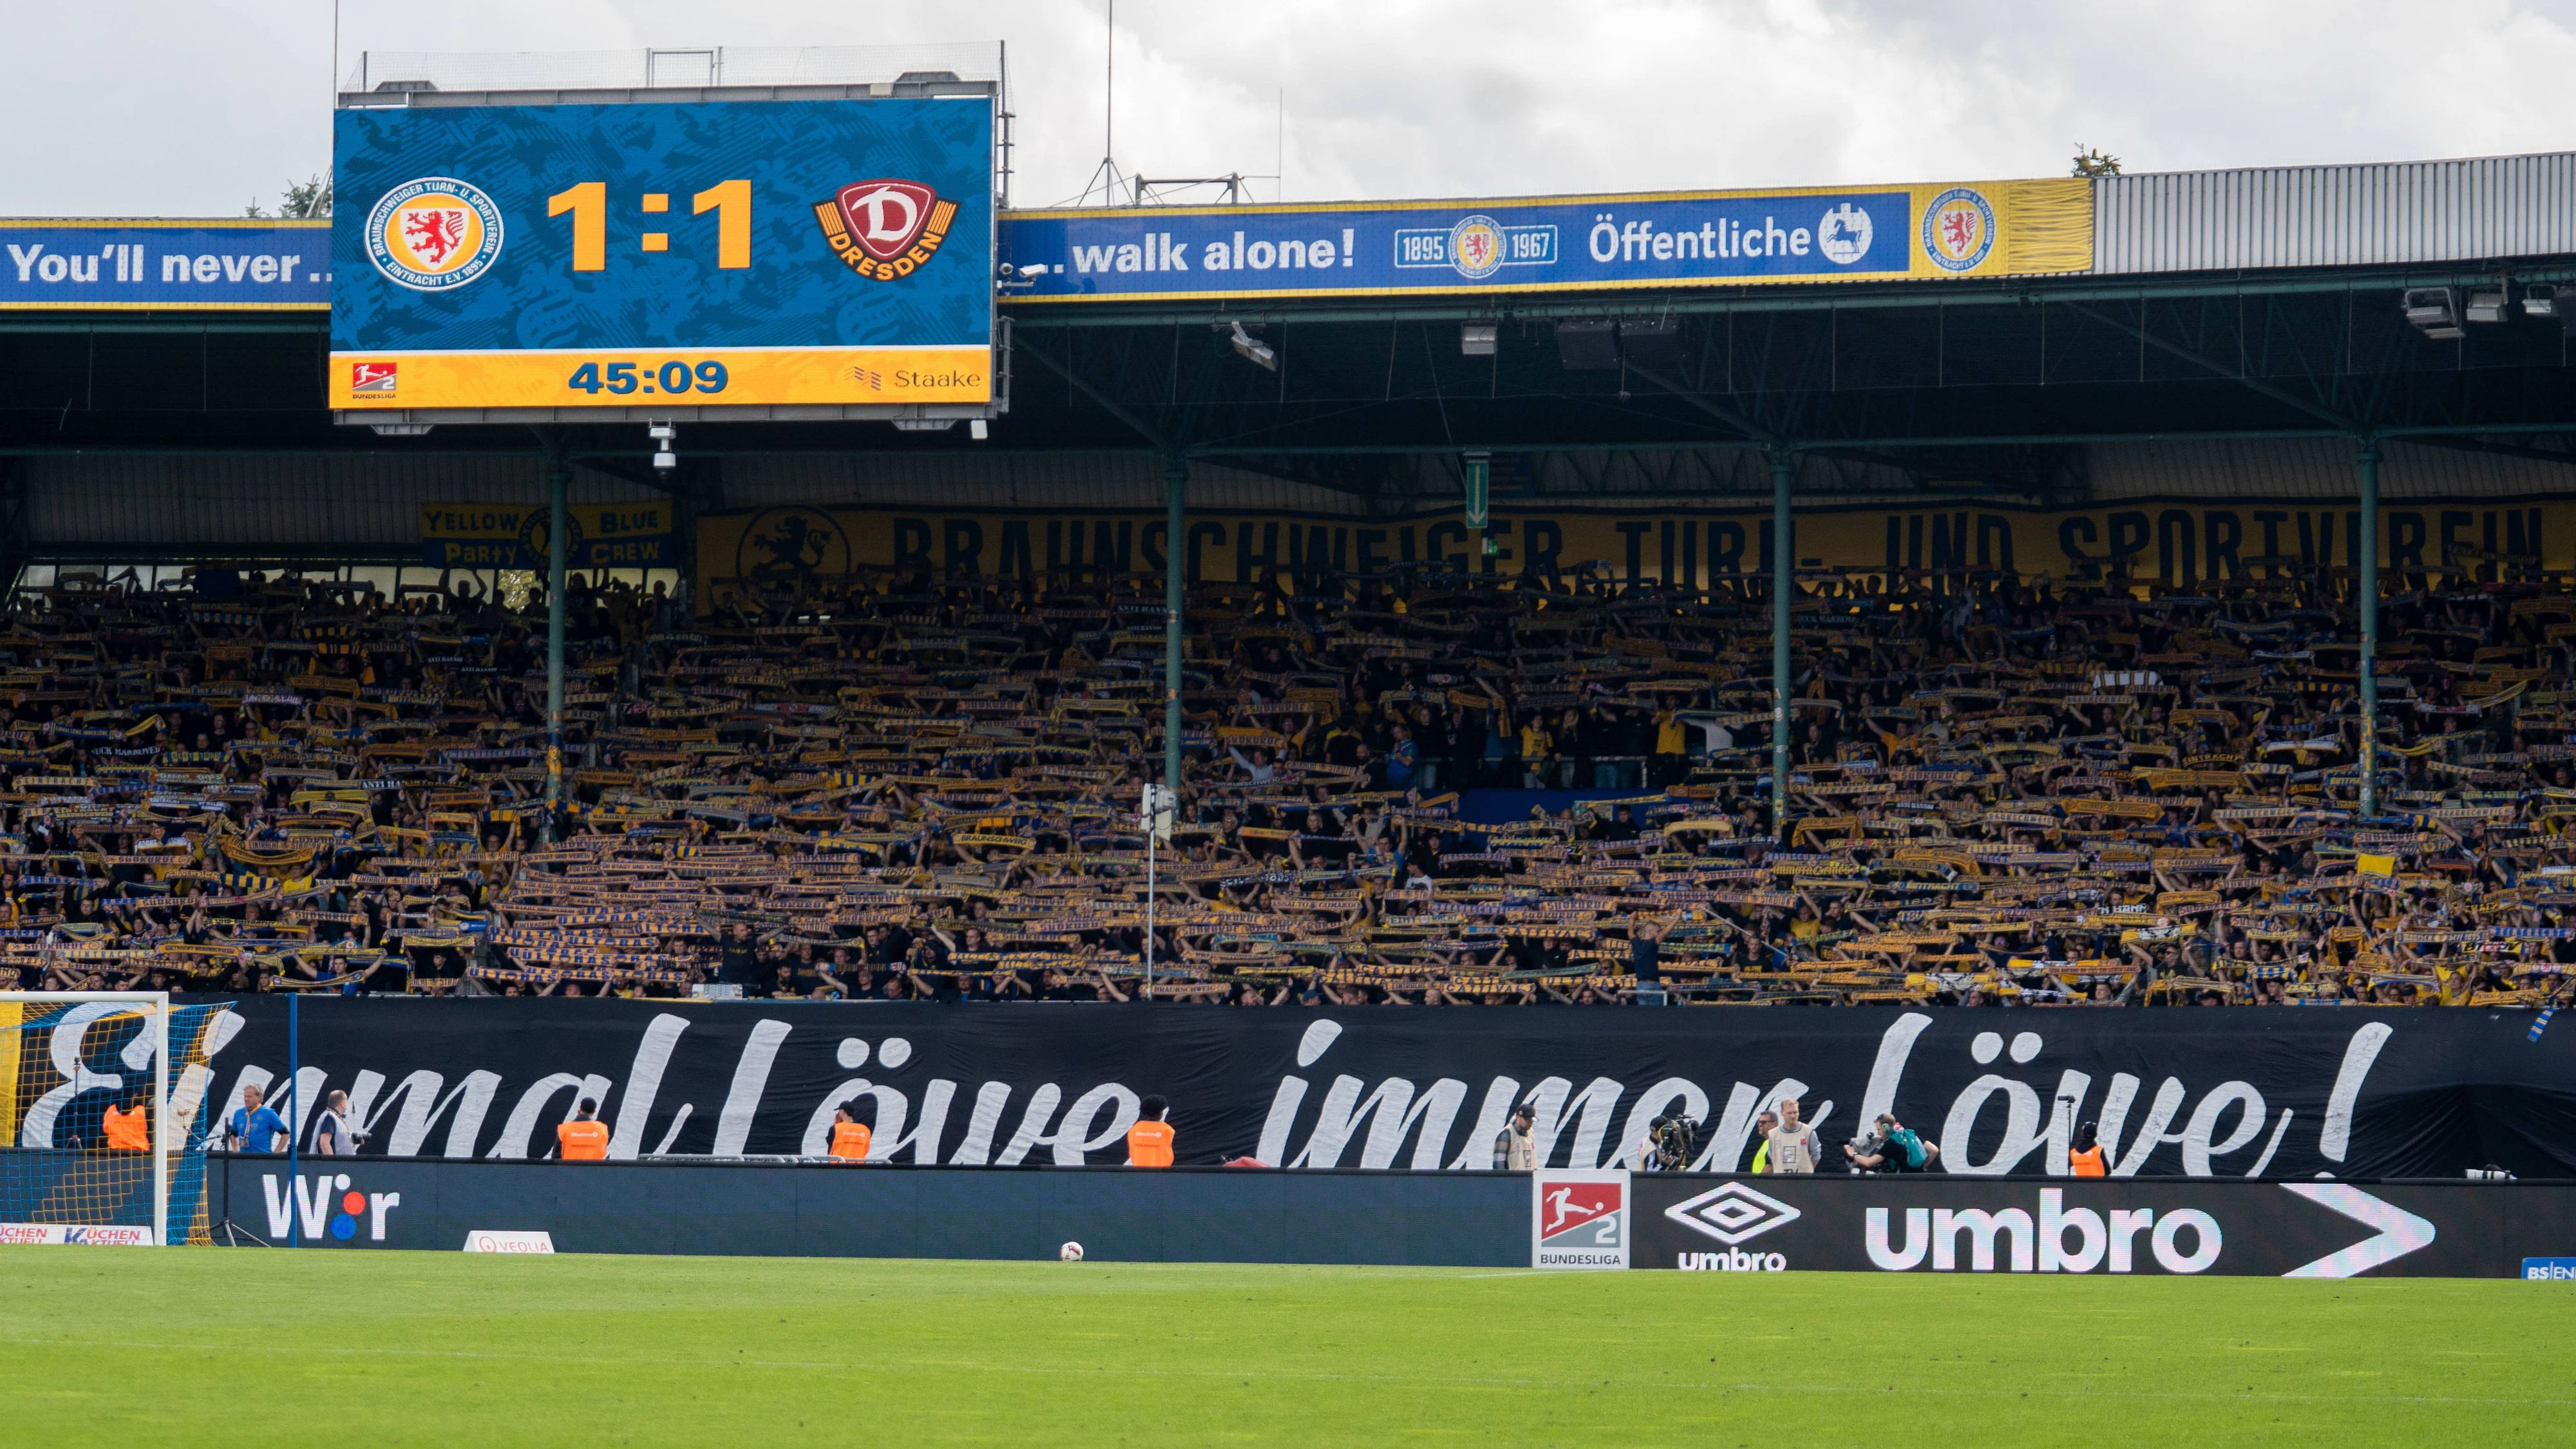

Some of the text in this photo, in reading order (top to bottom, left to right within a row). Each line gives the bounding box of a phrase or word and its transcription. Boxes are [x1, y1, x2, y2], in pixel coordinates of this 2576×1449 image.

[374, 184, 424, 256] BRAUNSCHWEIGER
[425, 181, 459, 193] TURN-
[469, 194, 497, 254] SPORTVEREIN
[1204, 228, 1354, 272] alone!
[1404, 238, 1444, 262] 1895
[1512, 232, 1549, 258] 1967
[1590, 213, 1811, 262] Öffentliche
[828, 231, 943, 281] DRESDEN
[386, 259, 484, 286] EINTRACHT E.V. 1895
[567, 360, 728, 395] 45:09
[894, 369, 981, 389] Staake
[363, 781, 384, 789] ANTI
[961, 835, 1028, 846] BRAUNSCHWEIG
[71, 950, 139, 958] EINTRACHT
[1256, 1019, 1833, 1172] immer
[0, 1224, 48, 1238] ÜCHEN
[1865, 1187, 2222, 1274] umbro
[498, 1241, 549, 1253] VEOLIA
[1540, 1253, 1621, 1265] BUNDESLIGA
[1678, 1247, 1788, 1271] umbro
